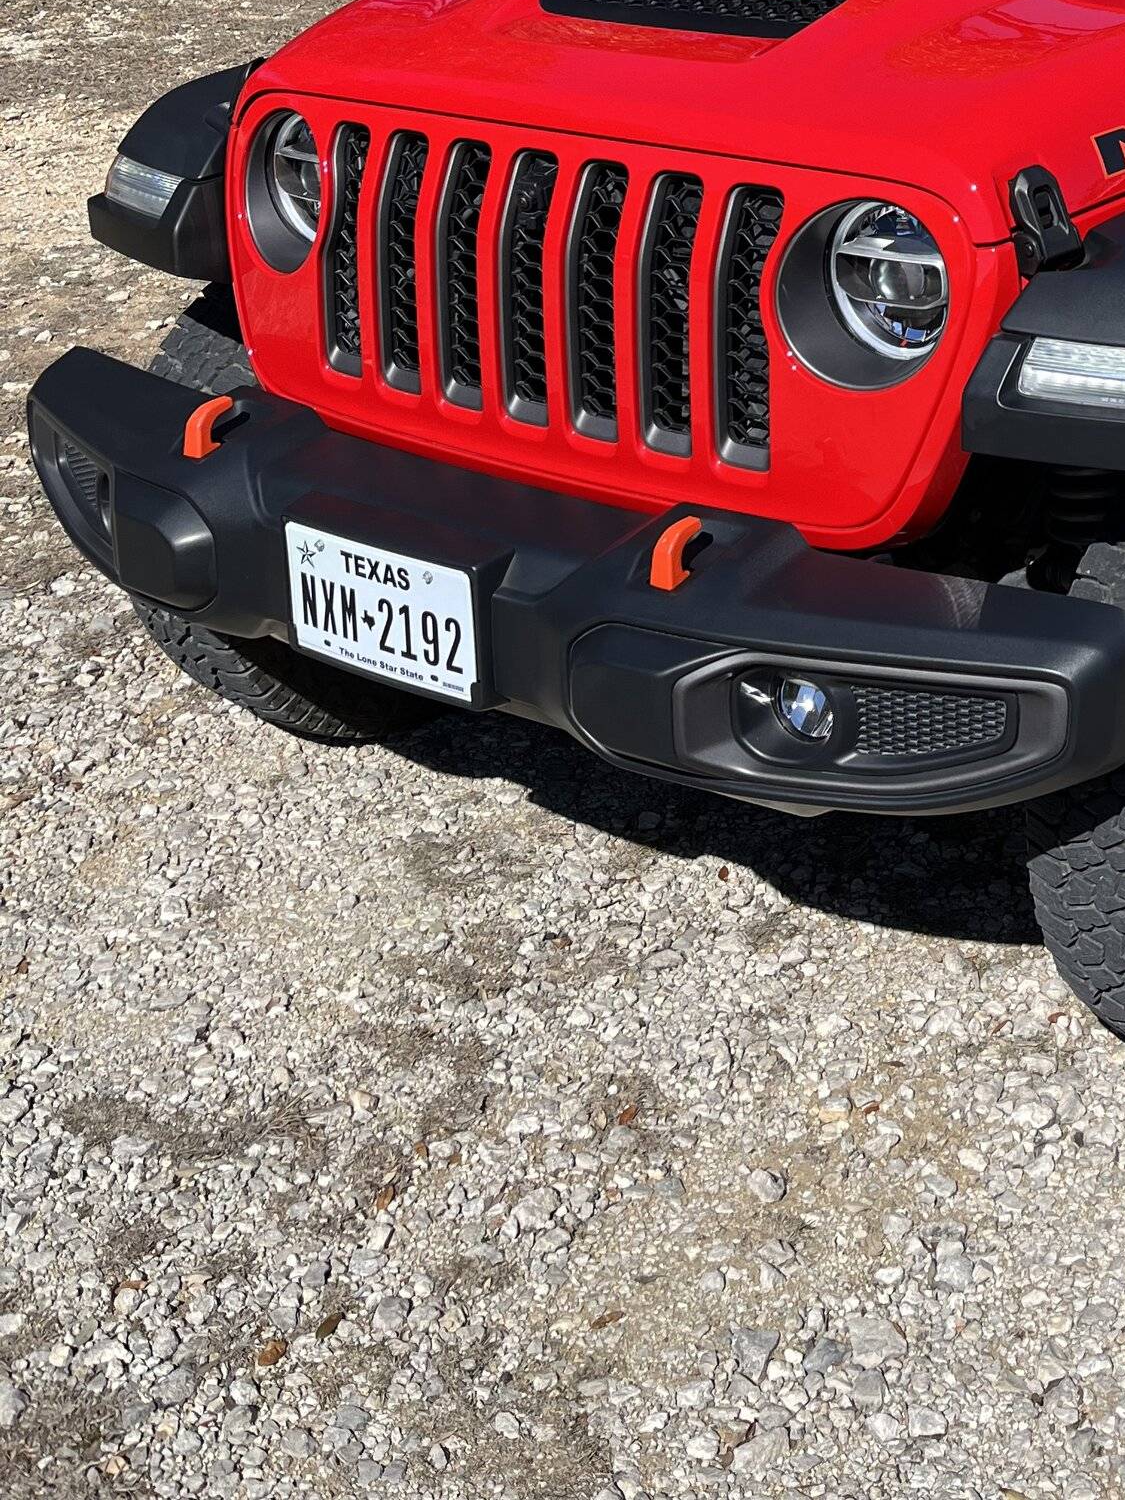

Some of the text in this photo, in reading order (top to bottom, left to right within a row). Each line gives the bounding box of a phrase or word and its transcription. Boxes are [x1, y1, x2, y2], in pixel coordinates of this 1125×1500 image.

[340, 550, 410, 591] TEXAS
[301, 572, 463, 675] NXM 2192
[339, 647, 423, 681] The Lone Star State
